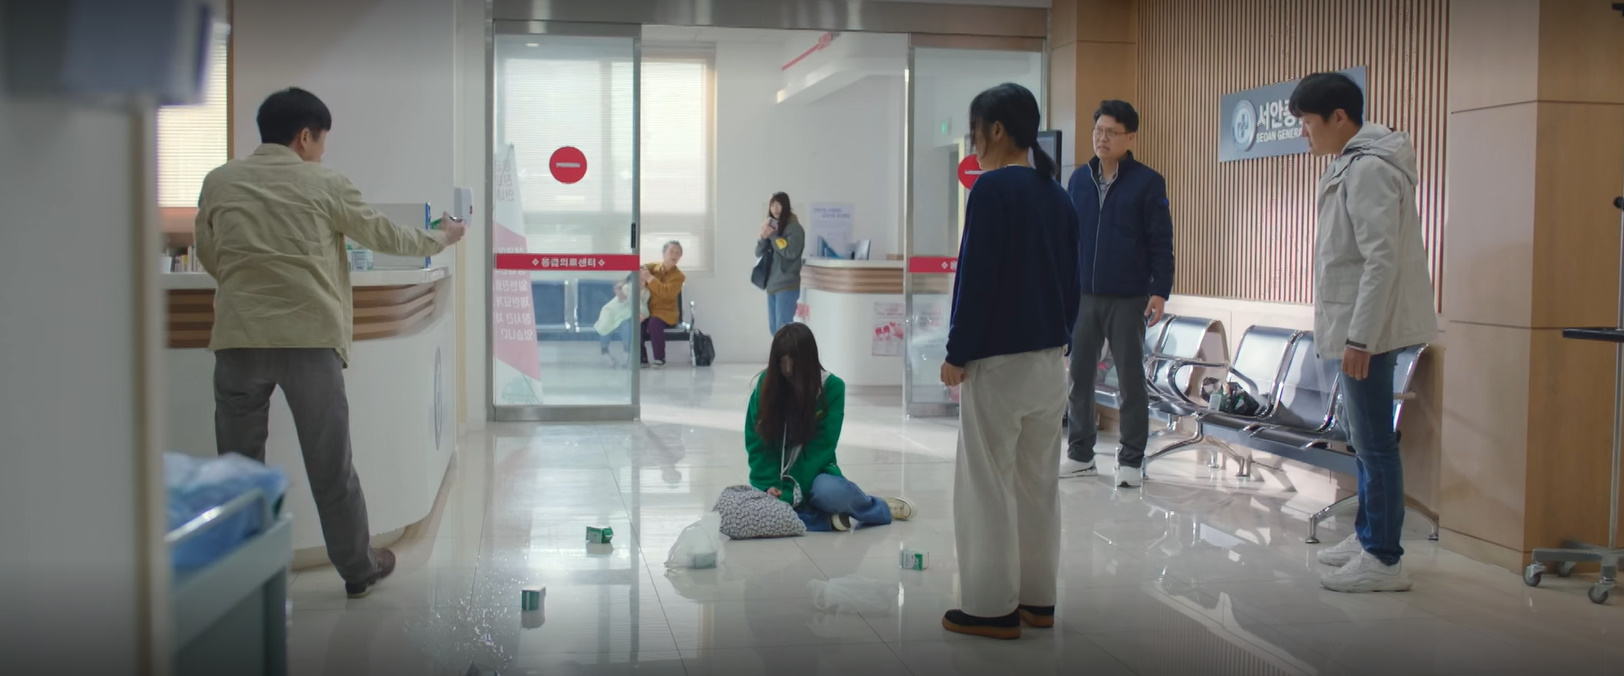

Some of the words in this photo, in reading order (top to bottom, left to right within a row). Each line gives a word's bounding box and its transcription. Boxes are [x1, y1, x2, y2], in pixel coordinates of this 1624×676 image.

[1257, 99, 1303, 130] 서안중
[1256, 131, 1277, 144] SEOAN
[541, 256, 596, 268] 응급의료센터
